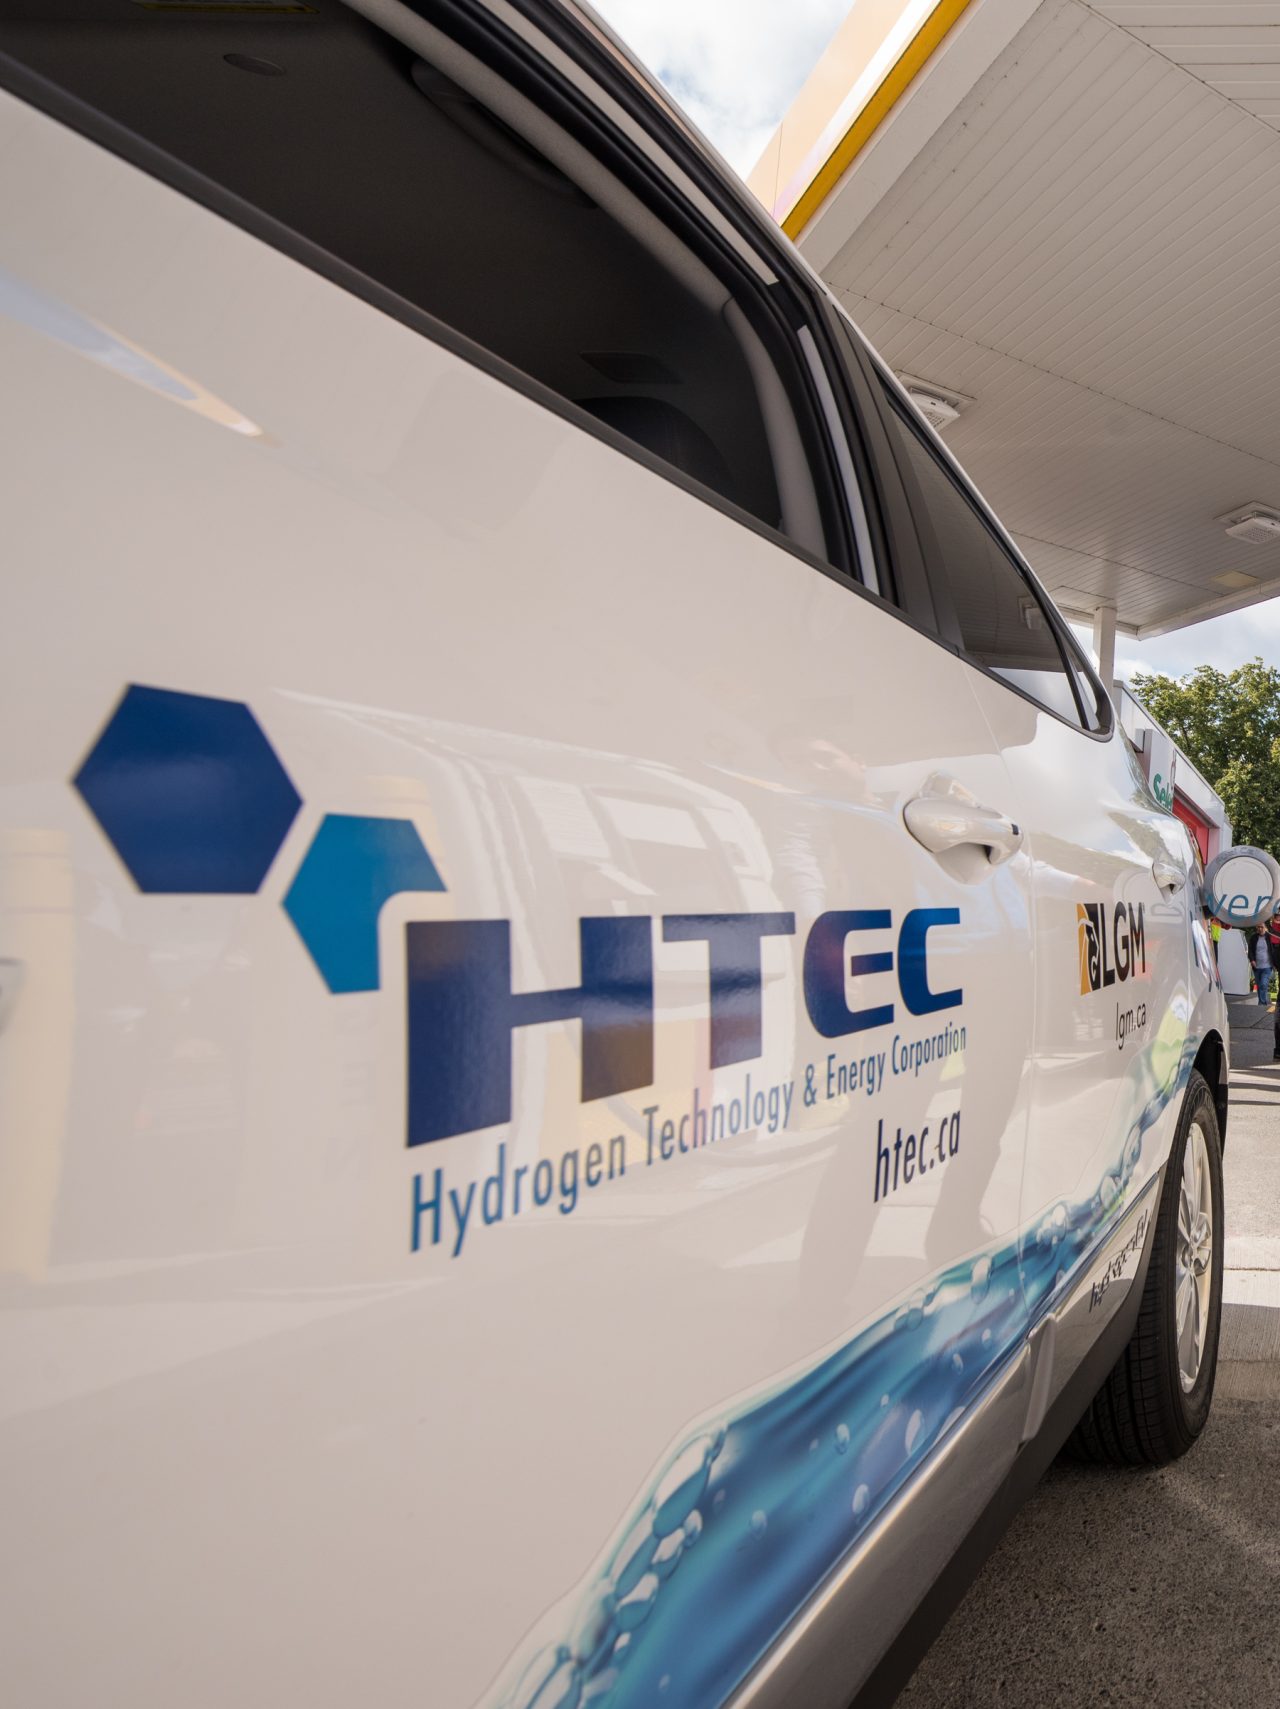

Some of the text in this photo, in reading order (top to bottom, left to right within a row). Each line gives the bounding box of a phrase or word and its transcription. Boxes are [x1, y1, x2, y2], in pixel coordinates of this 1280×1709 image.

[1100, 901, 1146, 988] LGM
[405, 907, 963, 1147] HTEC
[1115, 1002, 1147, 1051] lgm.ca
[410, 1021, 966, 1258] Hydrogen Technology & Energy Corporation
[873, 1110, 962, 1203] htec.ca
